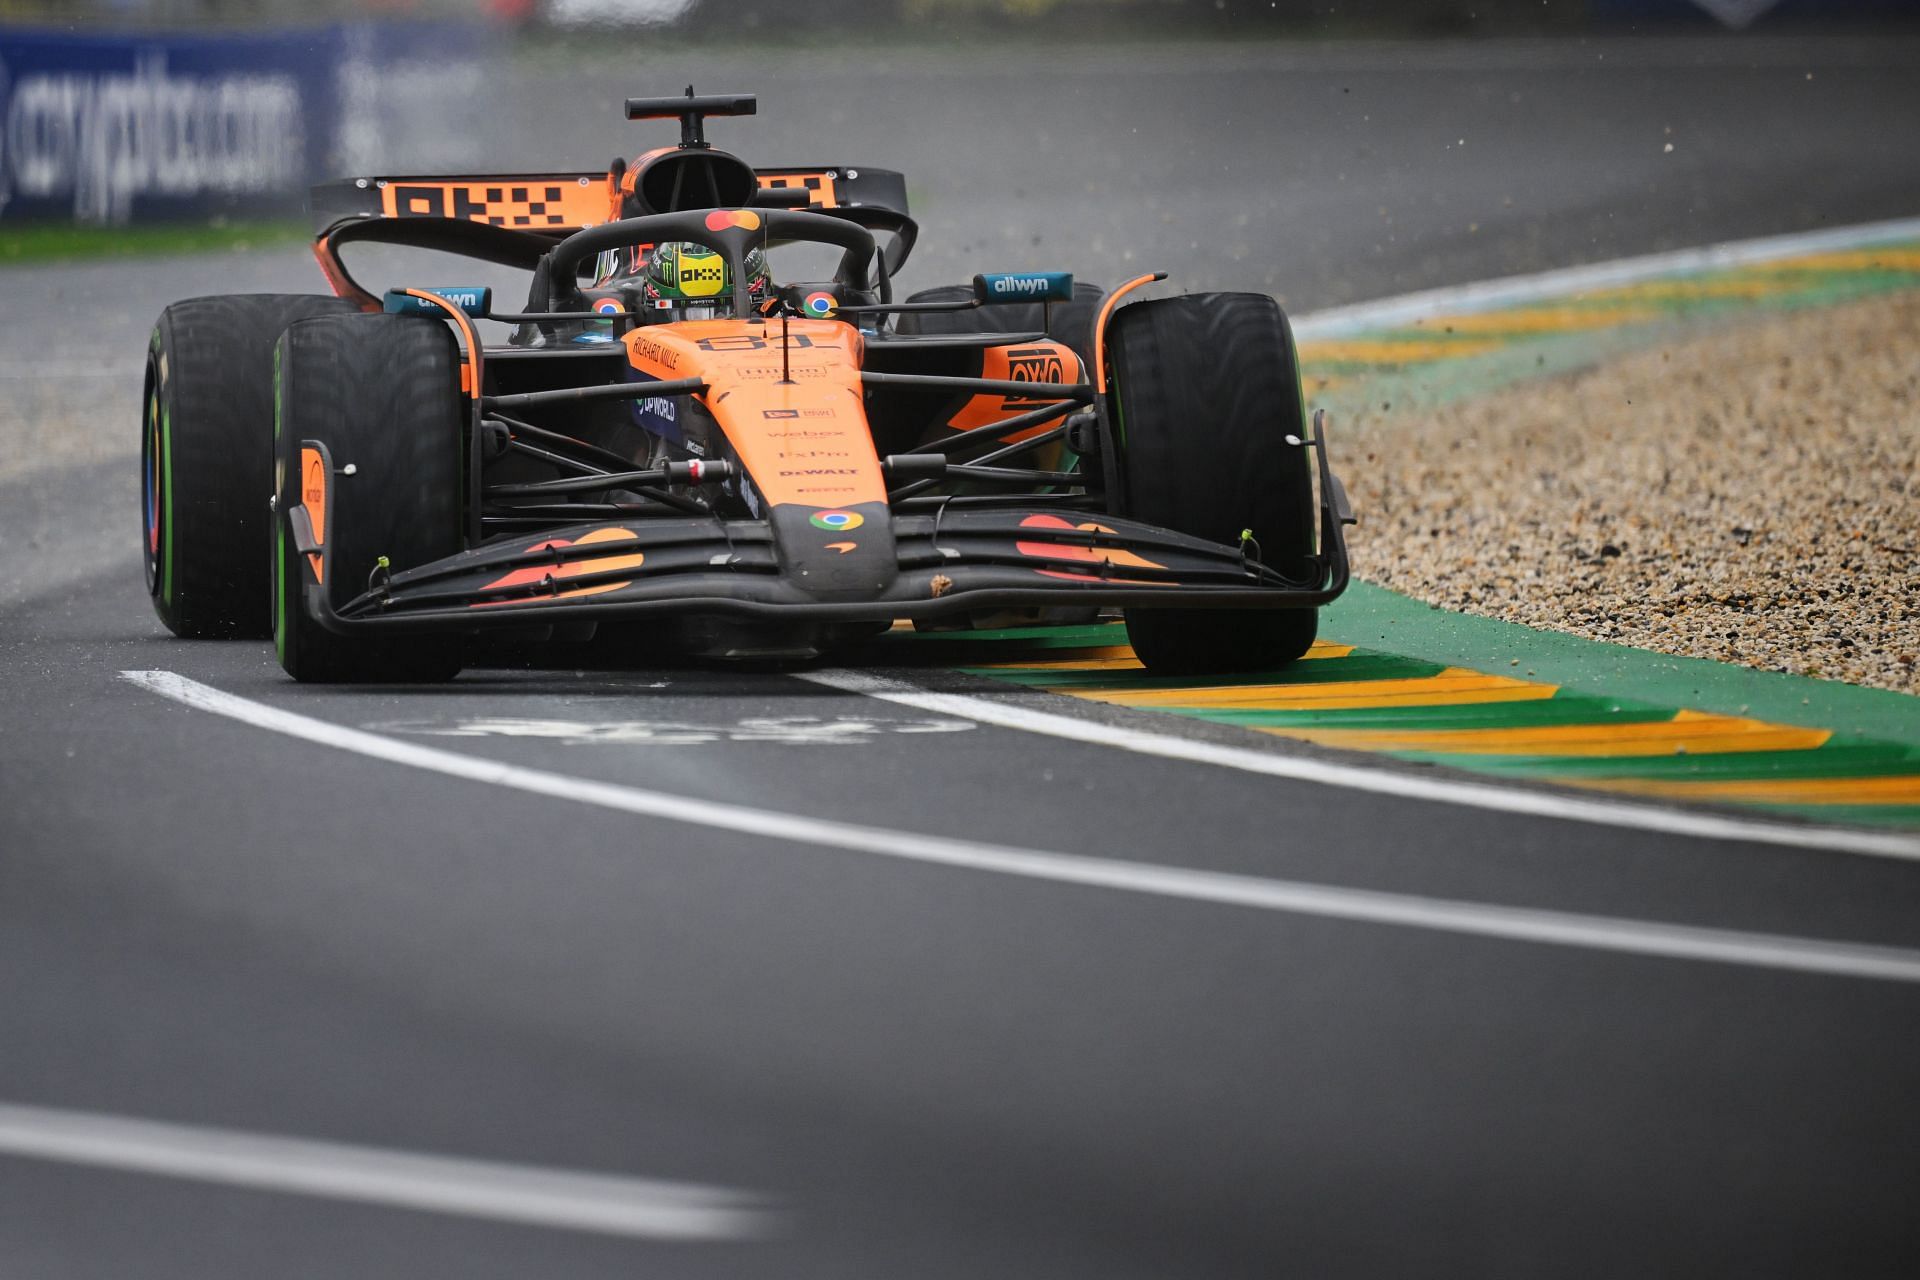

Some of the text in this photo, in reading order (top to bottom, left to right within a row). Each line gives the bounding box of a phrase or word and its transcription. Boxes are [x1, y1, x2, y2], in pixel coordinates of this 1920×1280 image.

[681, 268, 721, 283] OKX
[994, 276, 1049, 295] allwyn
[632, 337, 680, 370] RICHARD MILLE
[653, 397, 675, 422] WORLD
[766, 430, 845, 438] webex
